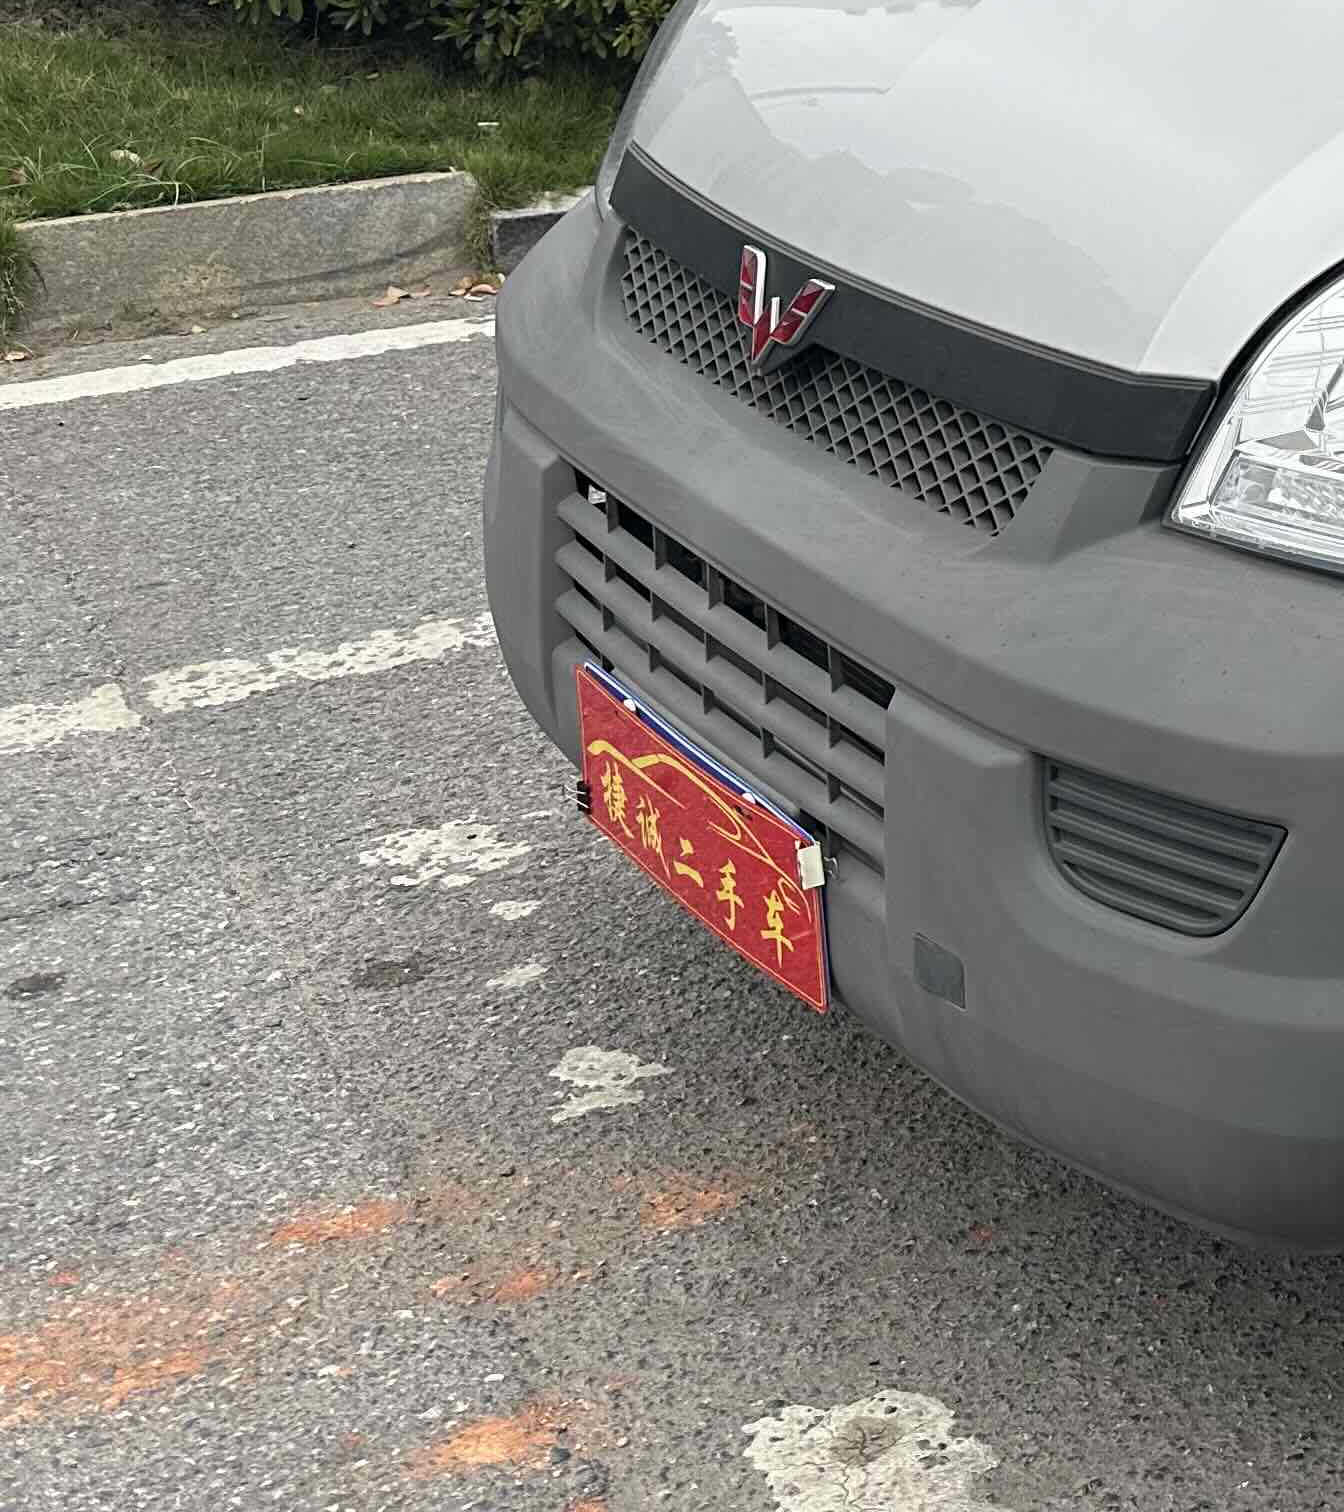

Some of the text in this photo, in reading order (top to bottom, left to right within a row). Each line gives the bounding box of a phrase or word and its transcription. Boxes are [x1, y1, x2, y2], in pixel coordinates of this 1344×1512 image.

[601, 760, 795, 969] 捷诚二手车
